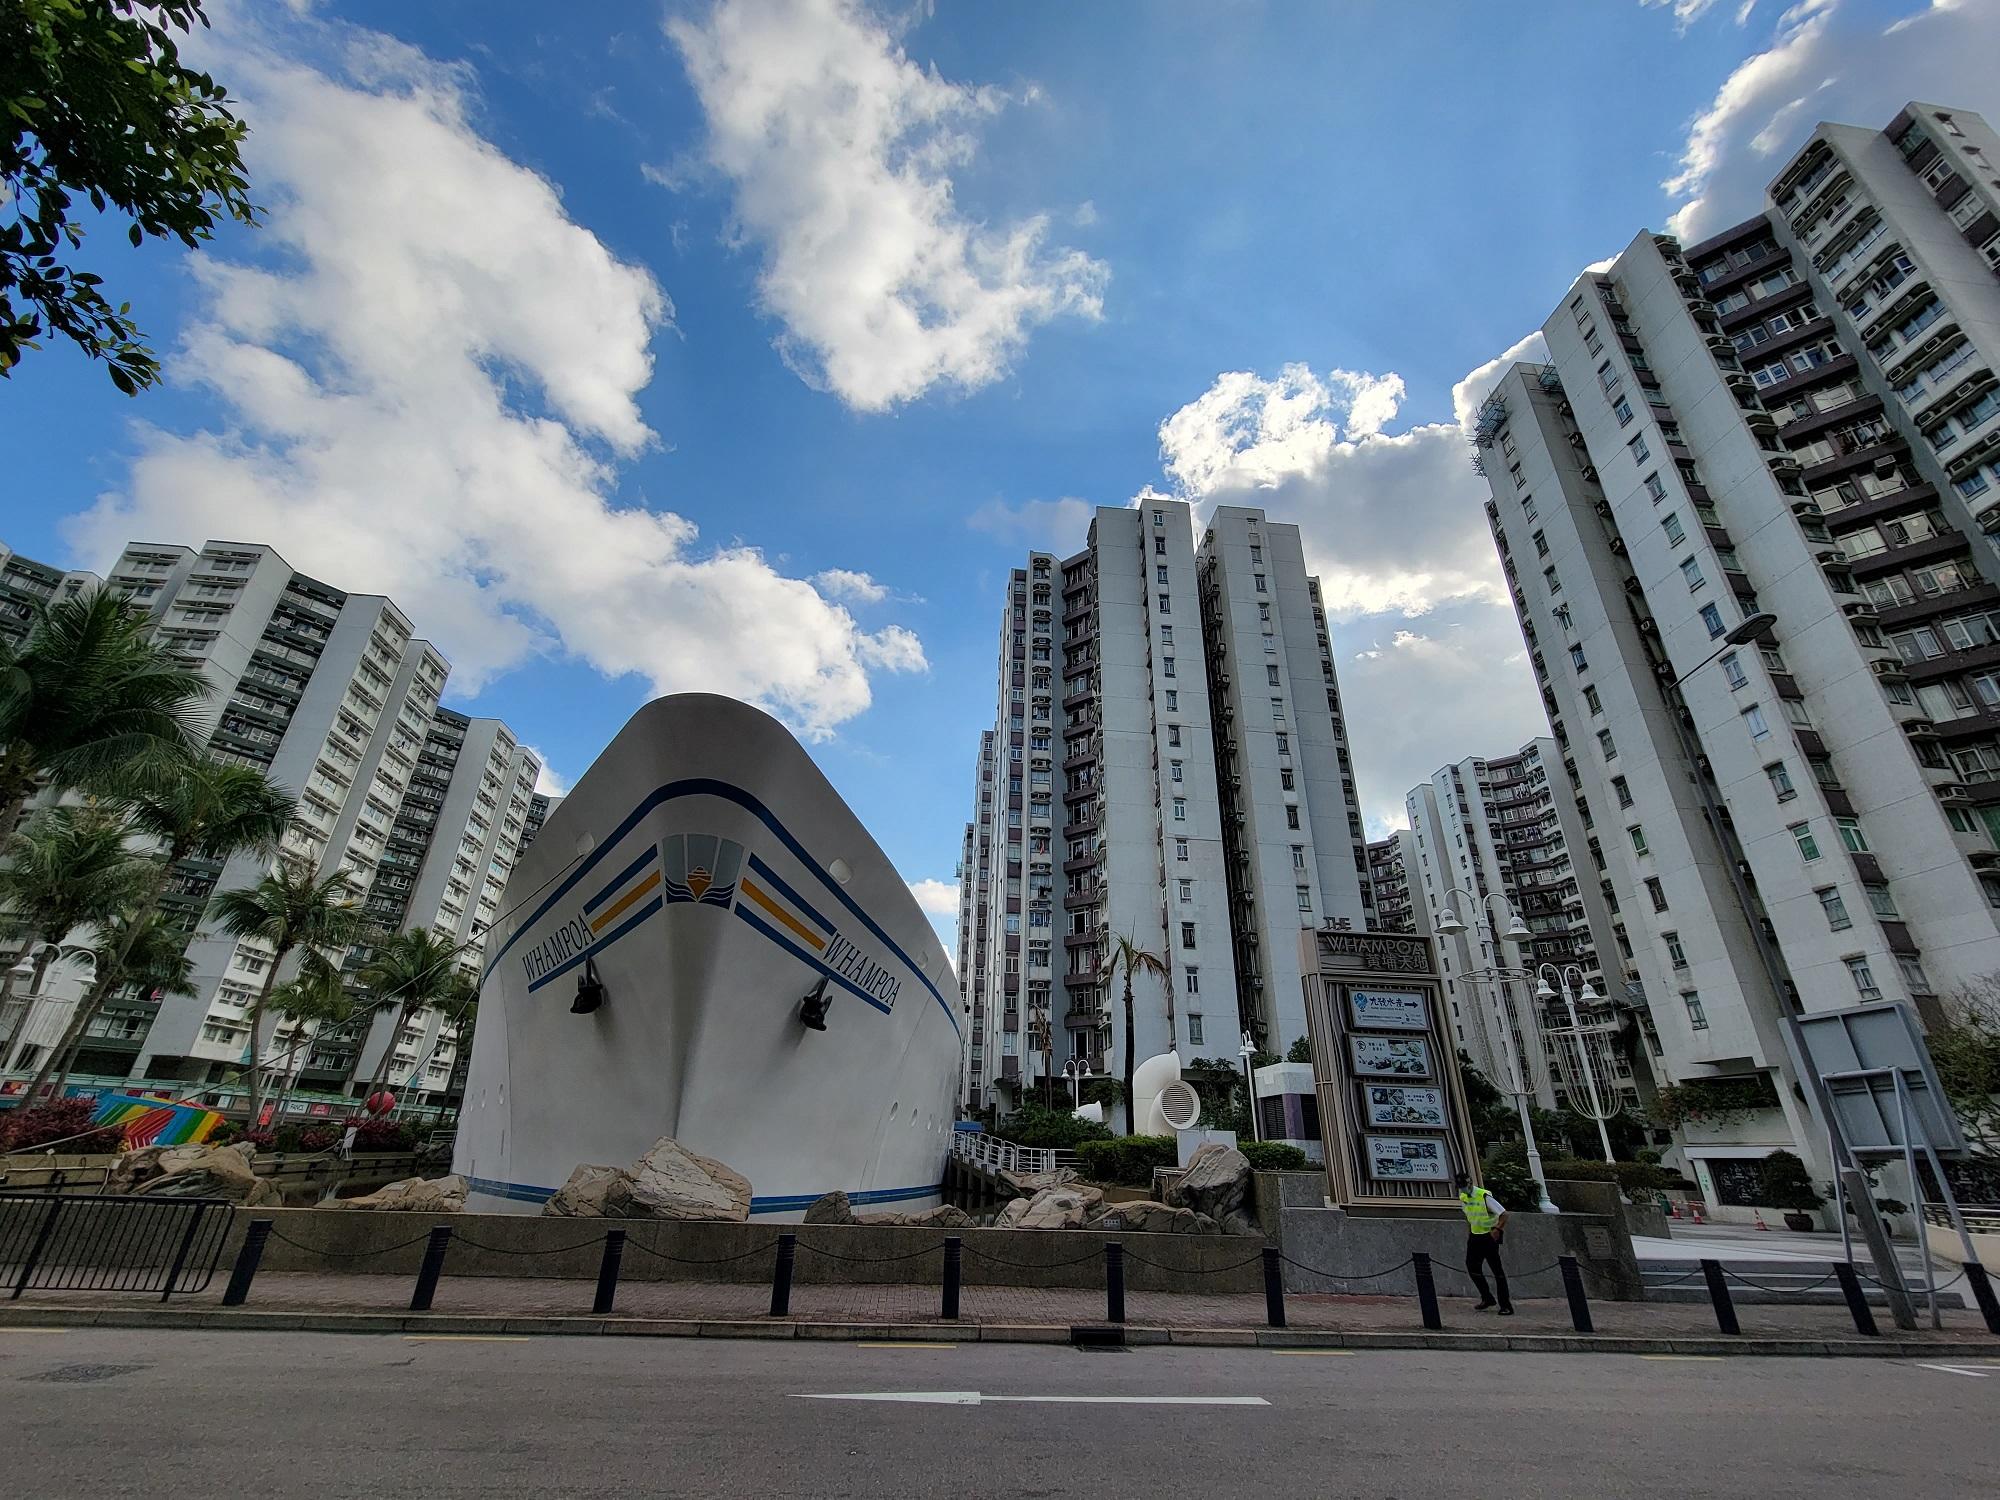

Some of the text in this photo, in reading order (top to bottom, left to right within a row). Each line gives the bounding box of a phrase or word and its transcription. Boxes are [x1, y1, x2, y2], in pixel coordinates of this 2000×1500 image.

[1320, 917, 1352, 930] THE
[1326, 935, 1425, 956] WHAMPOA
[522, 913, 596, 981] WHAMPOA
[823, 933, 901, 1007] WHAMPOA
